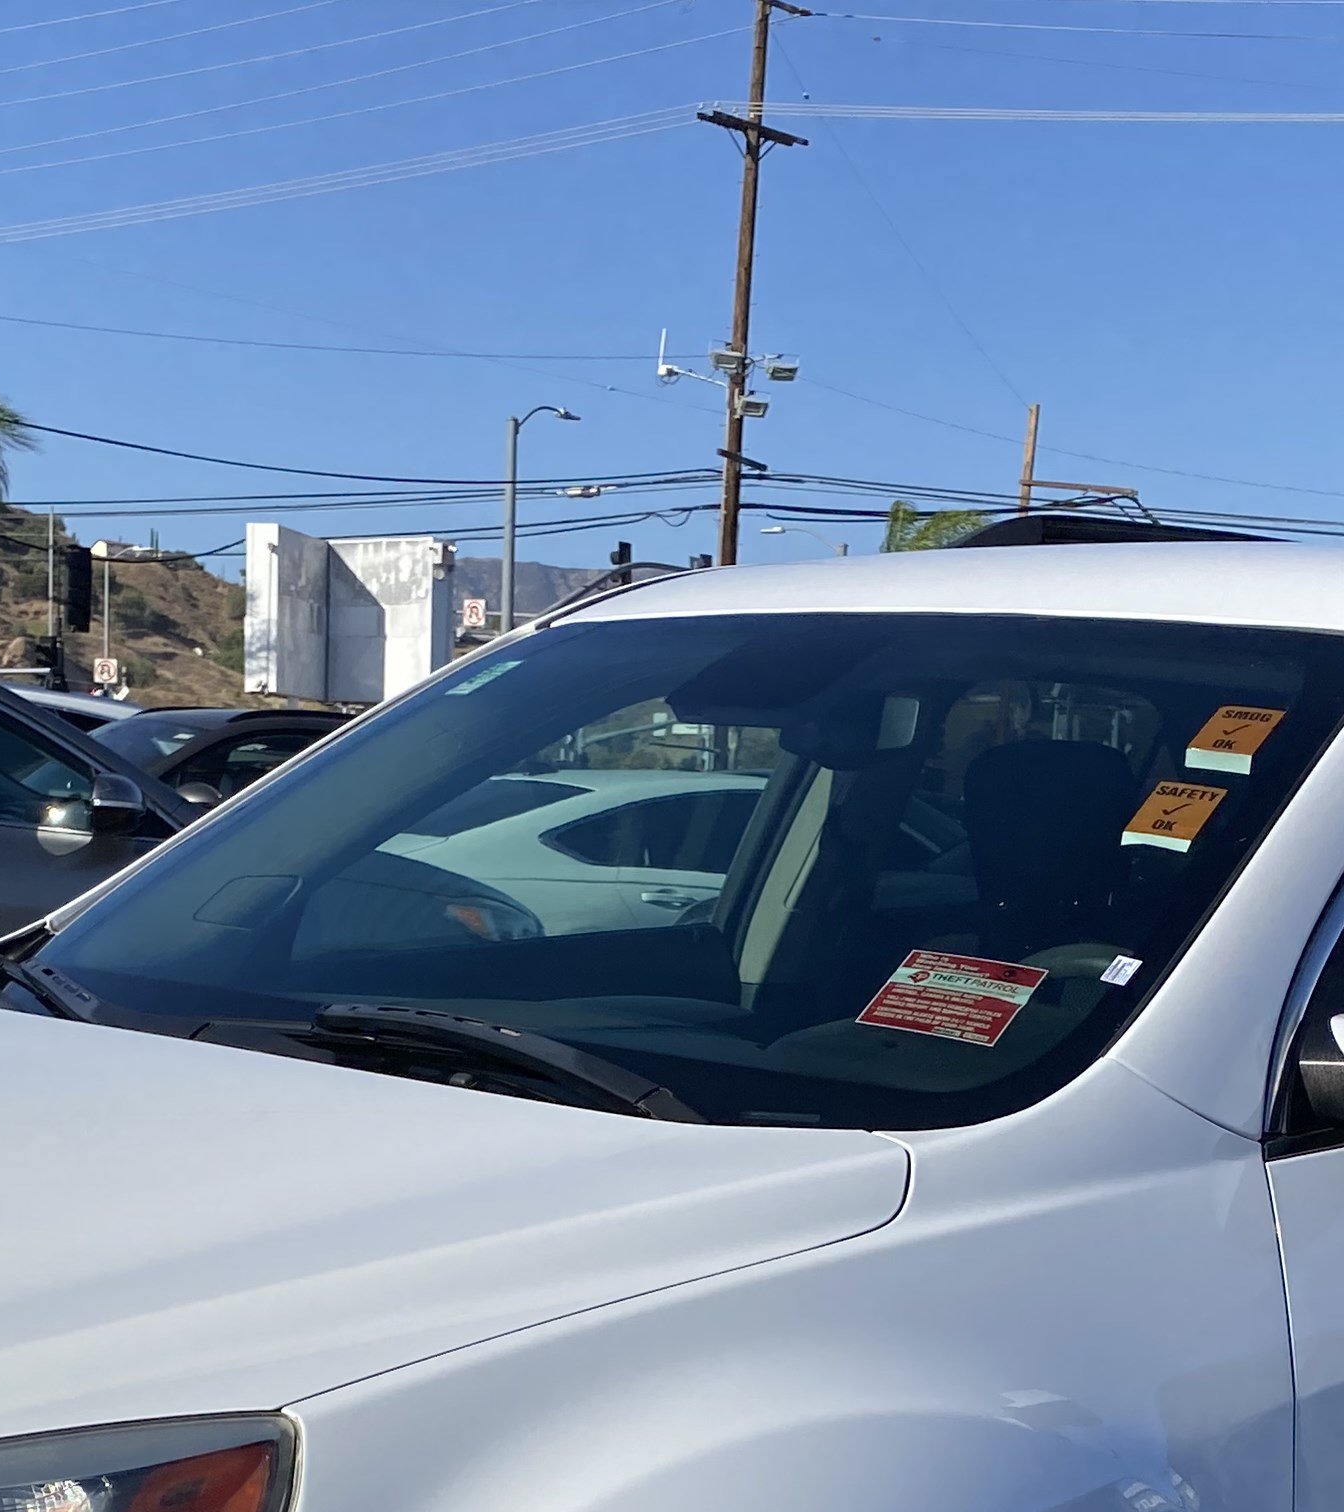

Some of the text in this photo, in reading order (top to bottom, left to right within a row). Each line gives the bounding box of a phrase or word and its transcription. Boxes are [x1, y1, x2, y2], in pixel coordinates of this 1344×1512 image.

[1222, 710, 1272, 722] SMOG
[1212, 739, 1236, 750] OK
[1156, 786, 1220, 802] SAFETY
[1151, 819, 1176, 832] OK
